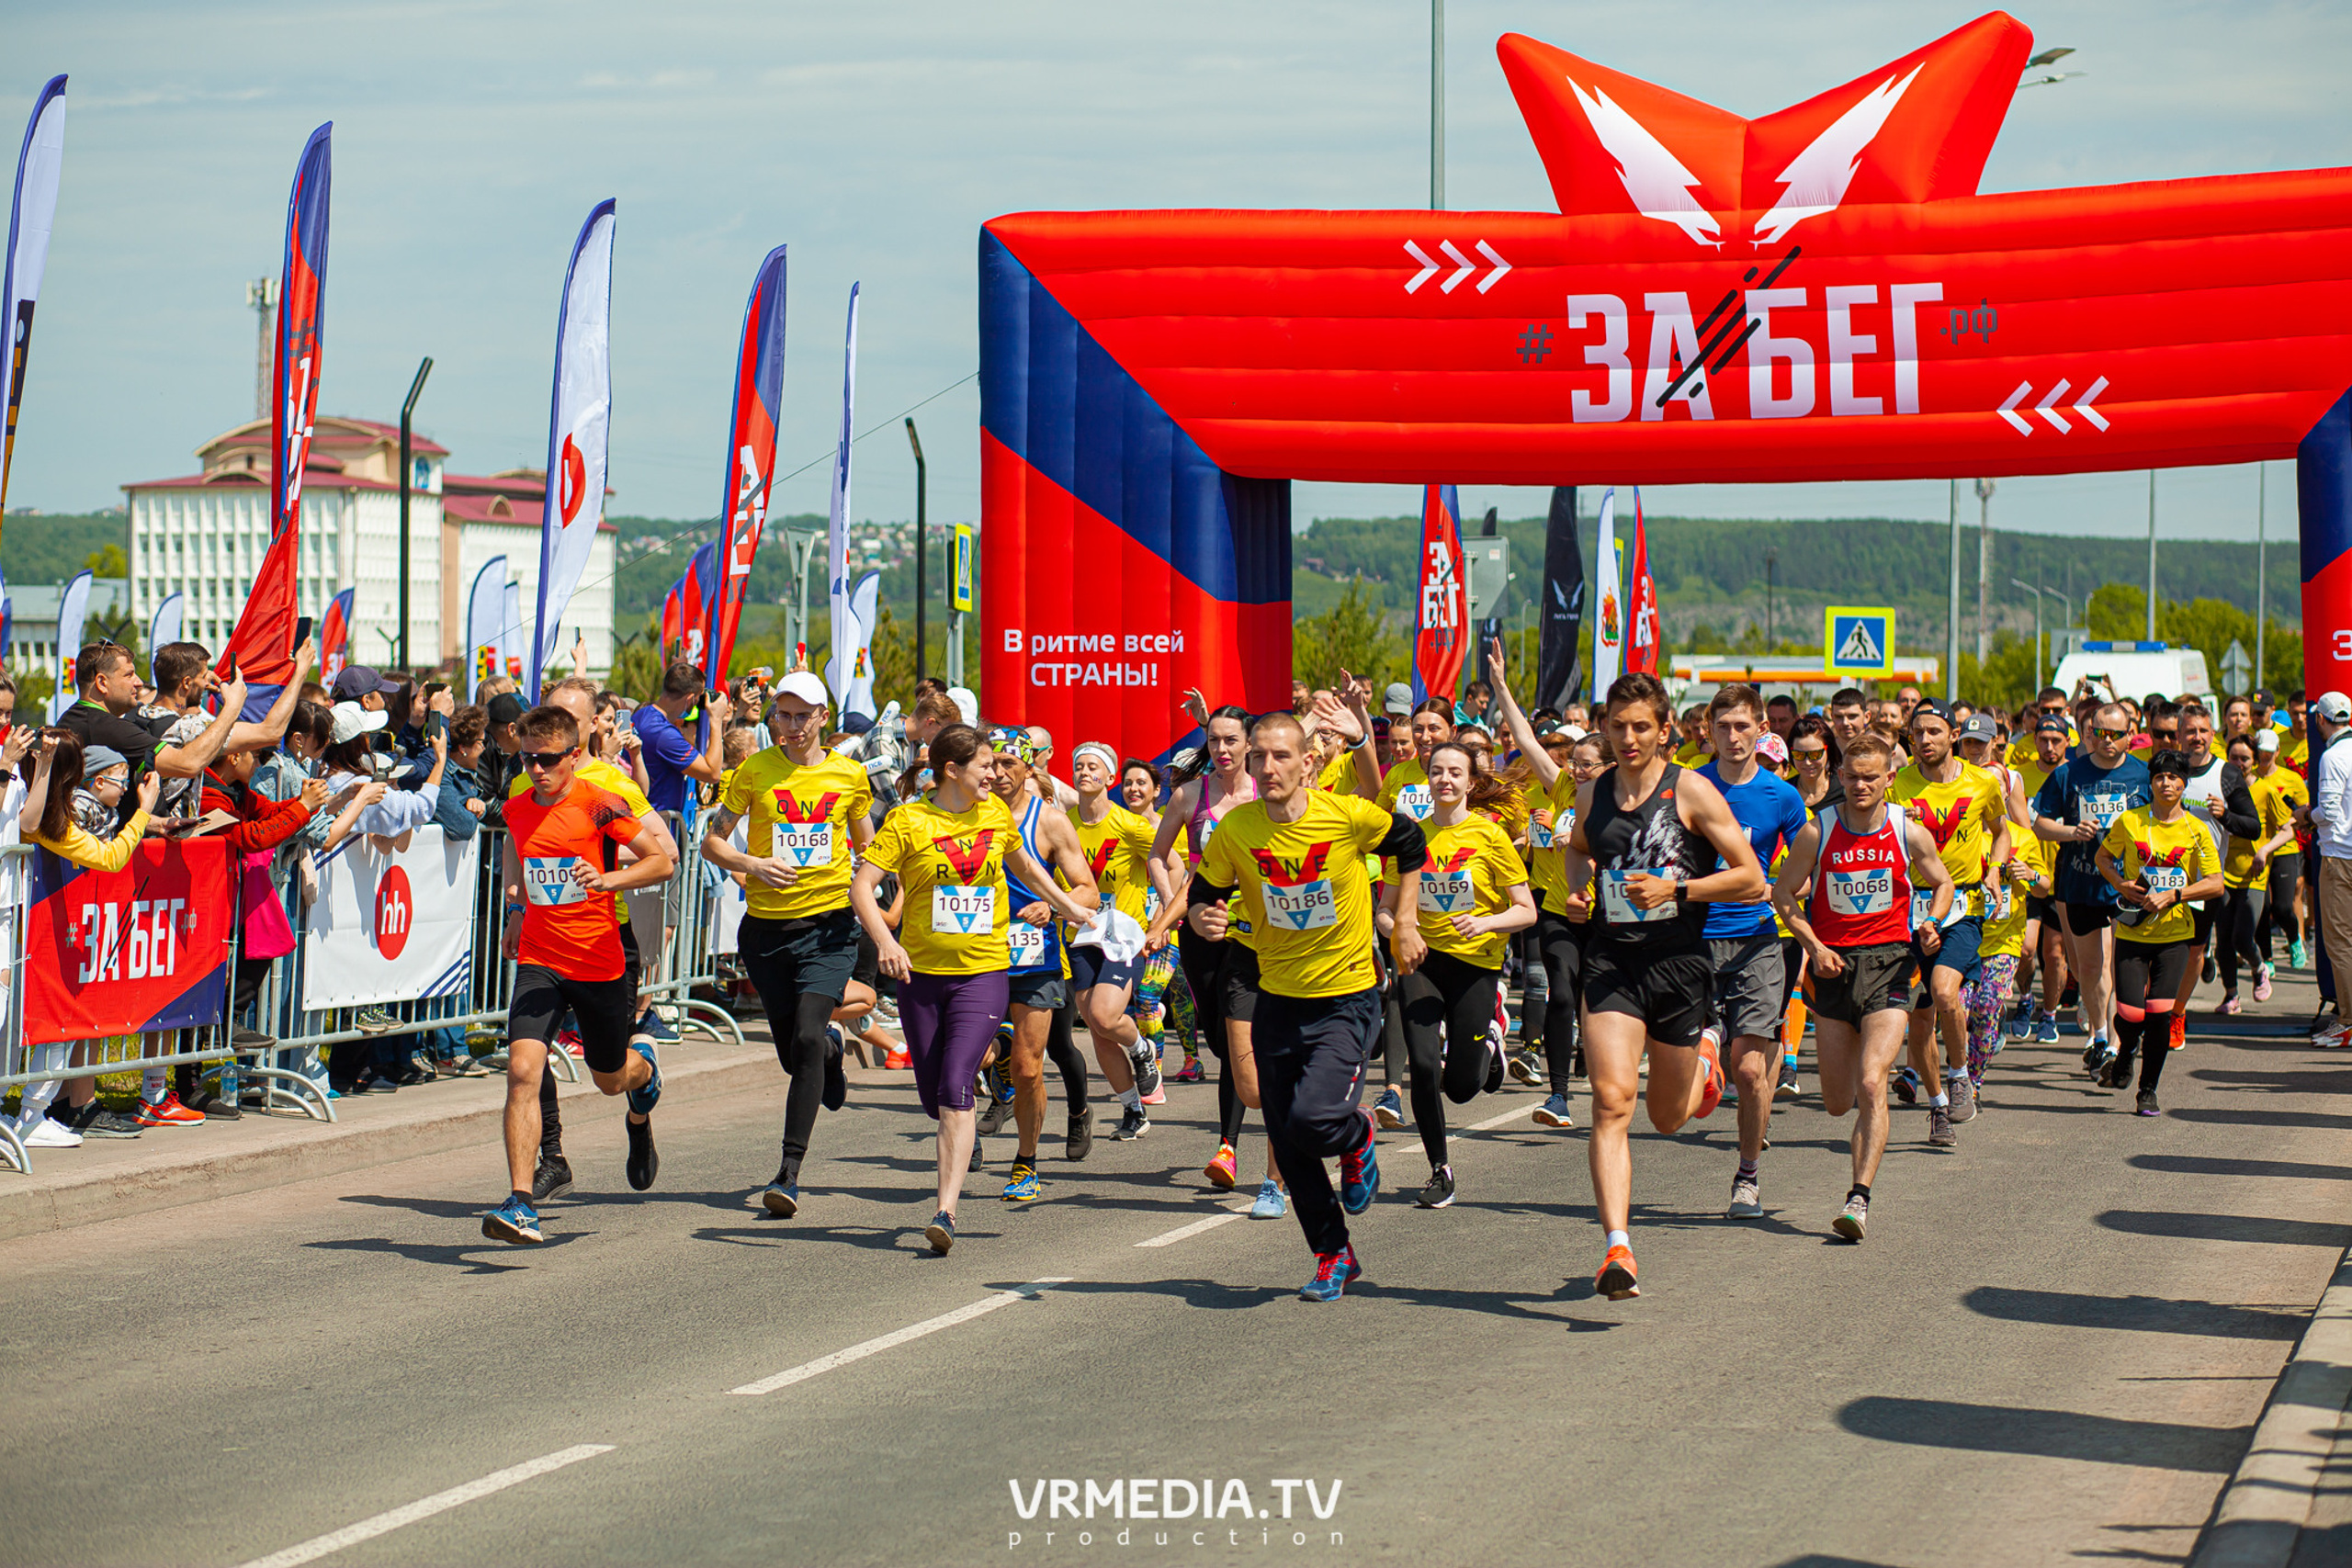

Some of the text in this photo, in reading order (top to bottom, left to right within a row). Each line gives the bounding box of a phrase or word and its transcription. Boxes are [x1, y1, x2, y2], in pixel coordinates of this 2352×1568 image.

[1003, 629, 1185, 657] В ритме всей
[1030, 662, 1159, 687] СТРАНЫ!
[776, 798, 834, 817] ONE
[2083, 802, 2124, 814] 10136
[777, 833, 829, 847] 10168
[1258, 854, 1329, 877] ONE
[1832, 849, 1895, 864] RUSSIA
[936, 861, 997, 880] RUN
[1419, 881, 1469, 895] 10169
[1832, 879, 1889, 897] 10068
[2150, 875, 2185, 888] 0183
[938, 897, 990, 913] 10175
[1268, 891, 1329, 911] 10186
[379, 889, 406, 936] hh
